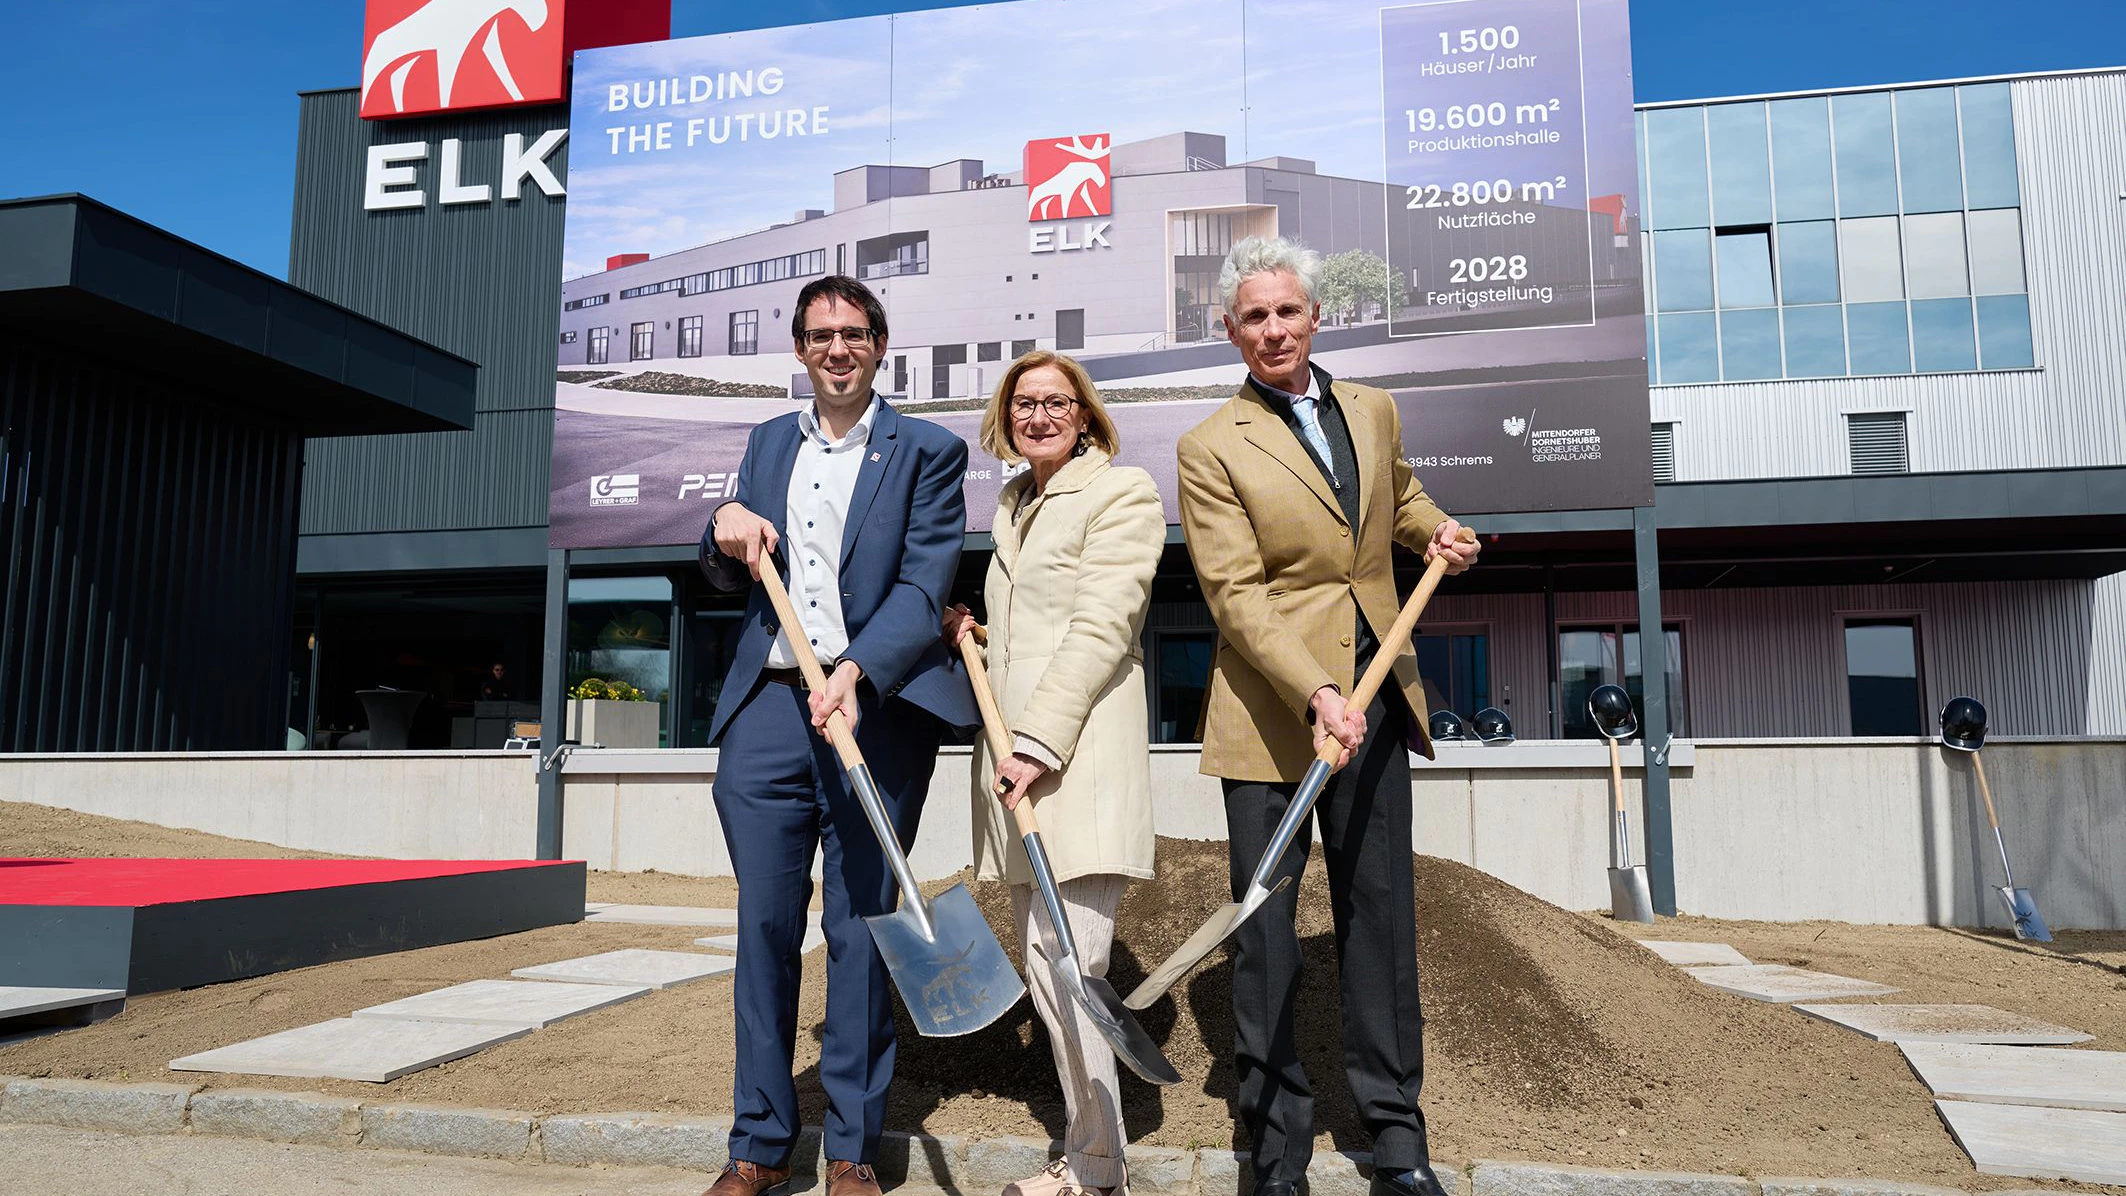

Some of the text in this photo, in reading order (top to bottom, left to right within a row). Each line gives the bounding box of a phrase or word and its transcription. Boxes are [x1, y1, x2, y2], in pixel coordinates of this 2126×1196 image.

[1439, 25, 1520, 55] 1.500
[608, 67, 785, 112] BUILDING
[606, 106, 830, 155] THE FUTURE
[1406, 102, 1507, 132] 19.600
[1408, 128, 1561, 154] Produktionshalle
[364, 128, 568, 210] ELK
[1405, 179, 1513, 209] 22.800
[1438, 210, 1536, 230] Nutzfläche
[1030, 222, 1111, 253] ELK
[1449, 254, 1528, 284] 2028
[1426, 284, 1553, 307] Fertigstellung
[1531, 428, 1596, 439] MITTENDORFER
[1531, 436, 1601, 446] DORNETSHUBER
[1440, 455, 1493, 467] Schrems
[1532, 444, 1601, 454] INGENIEURE UND
[1532, 452, 1602, 462] GENERALPLANER
